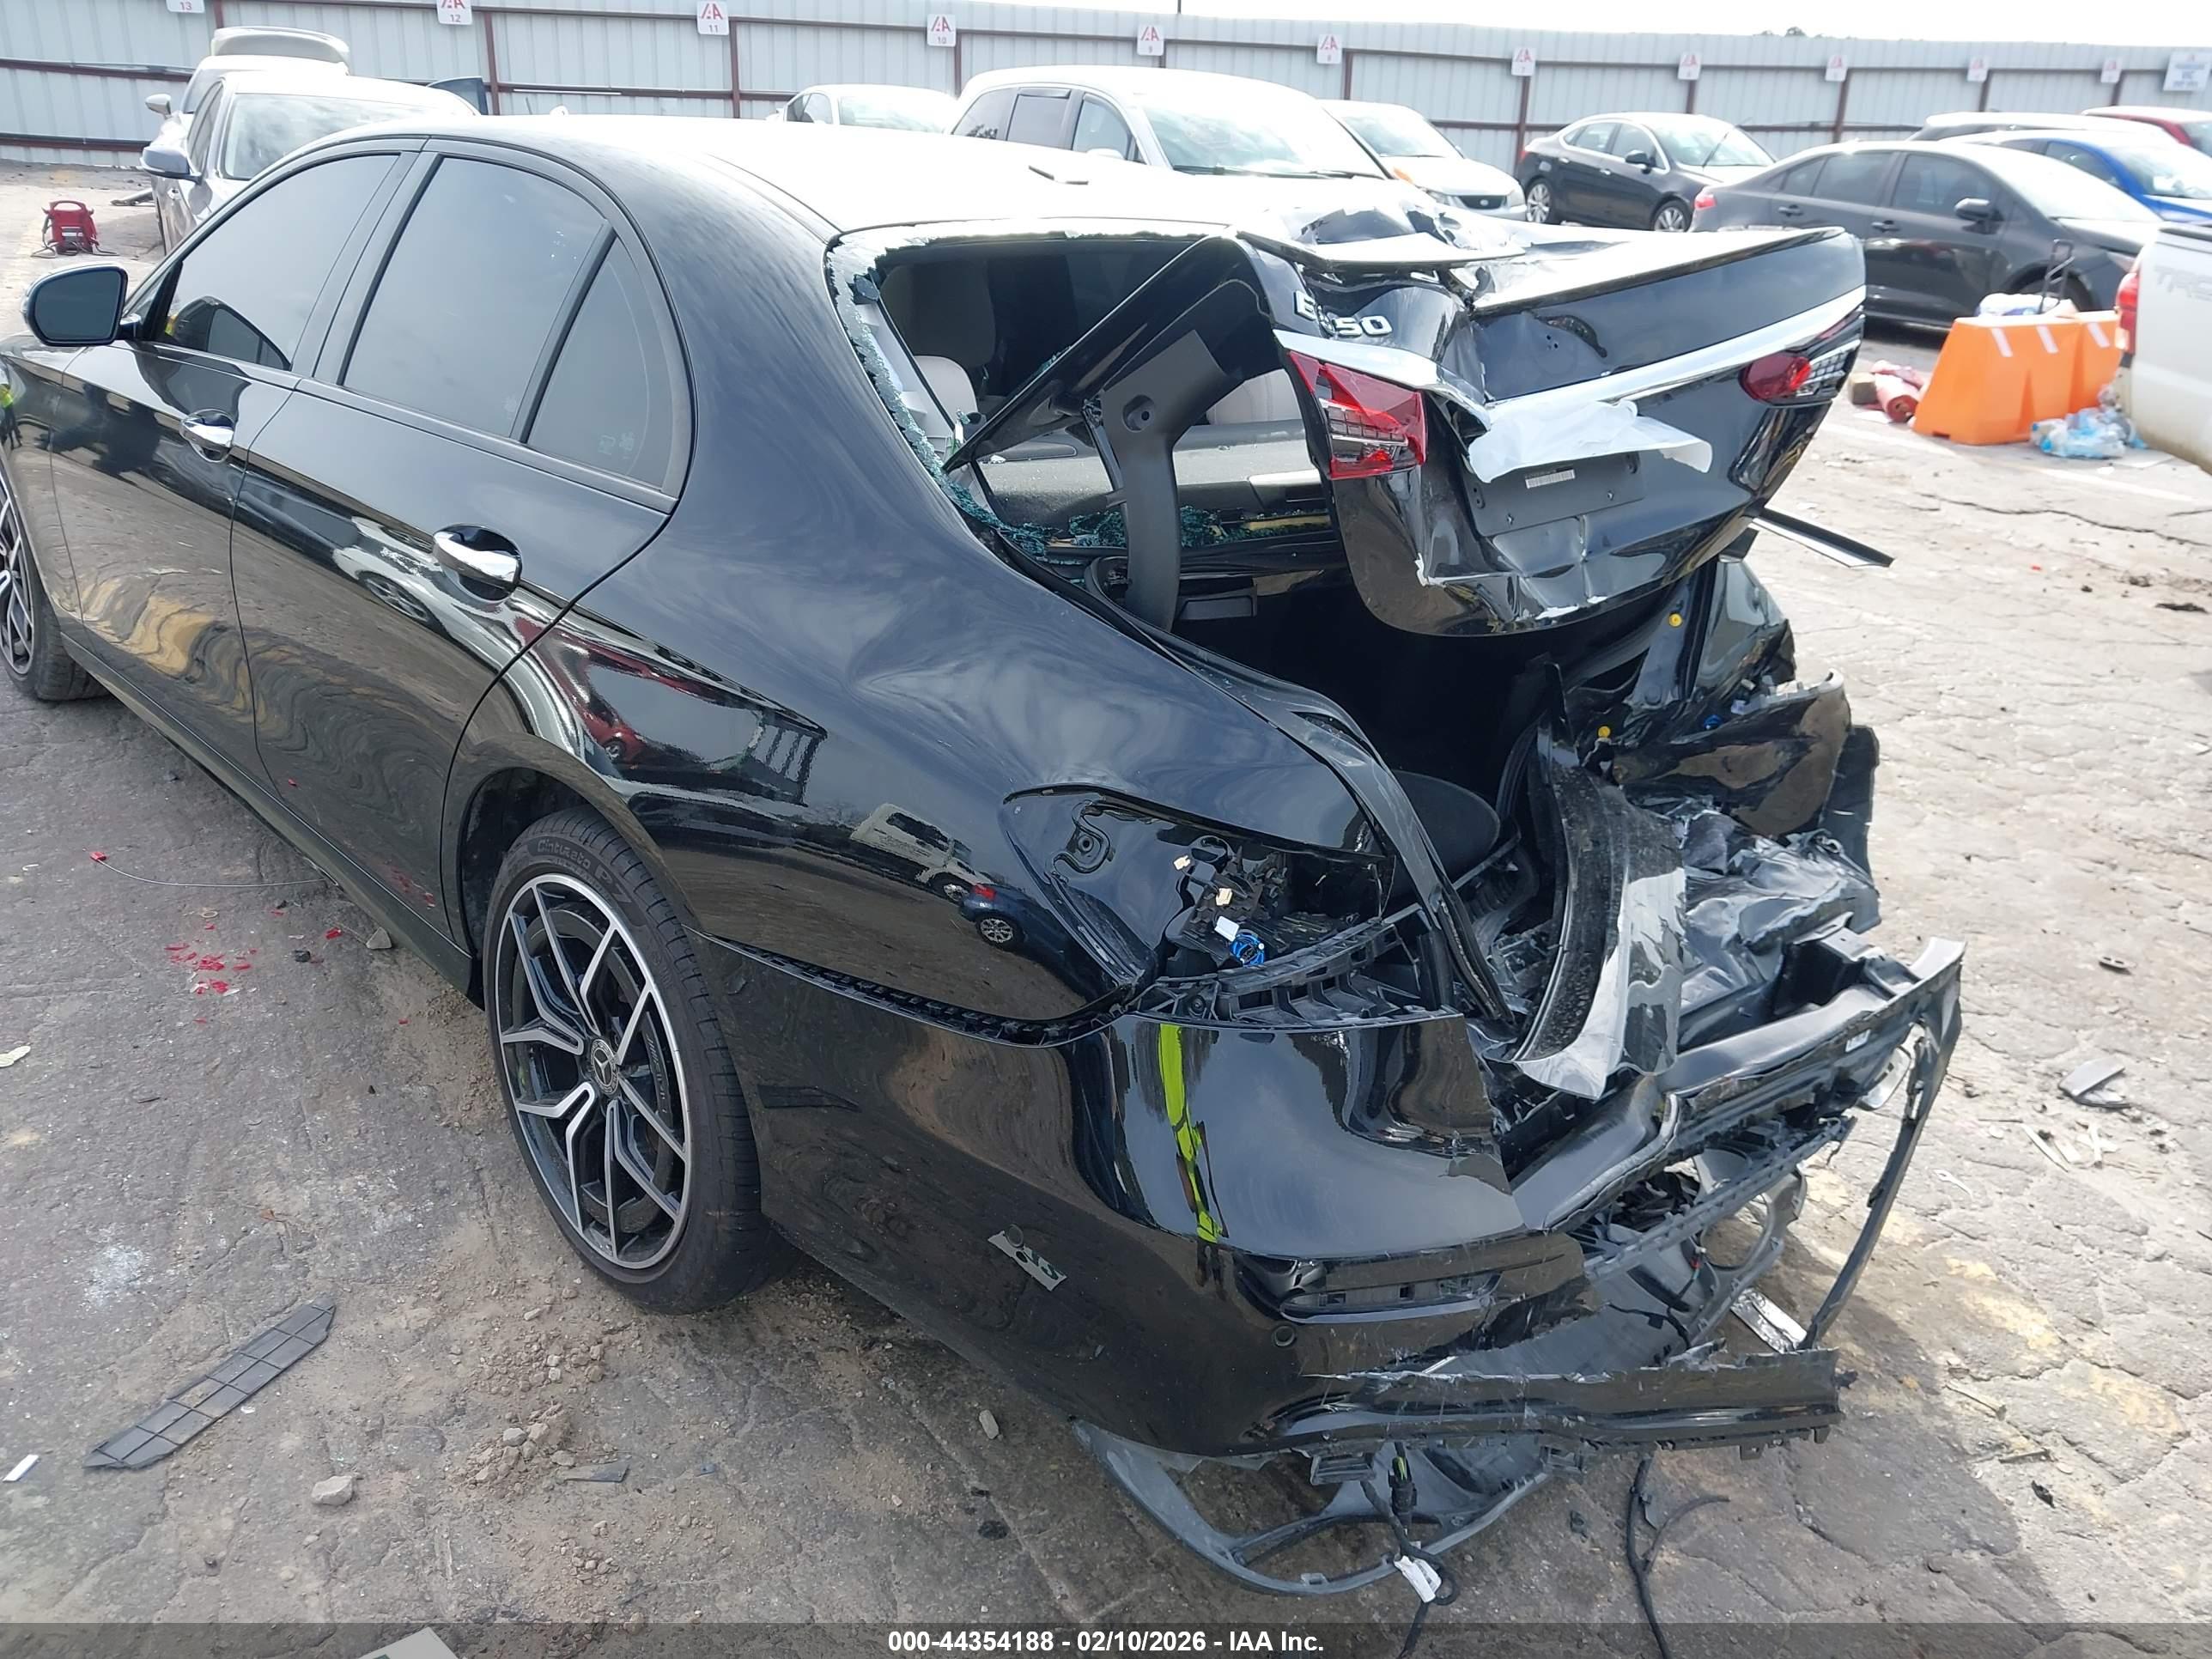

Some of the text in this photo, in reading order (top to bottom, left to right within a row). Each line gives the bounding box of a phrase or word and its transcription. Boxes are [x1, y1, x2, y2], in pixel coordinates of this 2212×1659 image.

[179, 2, 192, 10] 13
[450, 14, 461, 22] 12
[708, 24, 719, 33] 11
